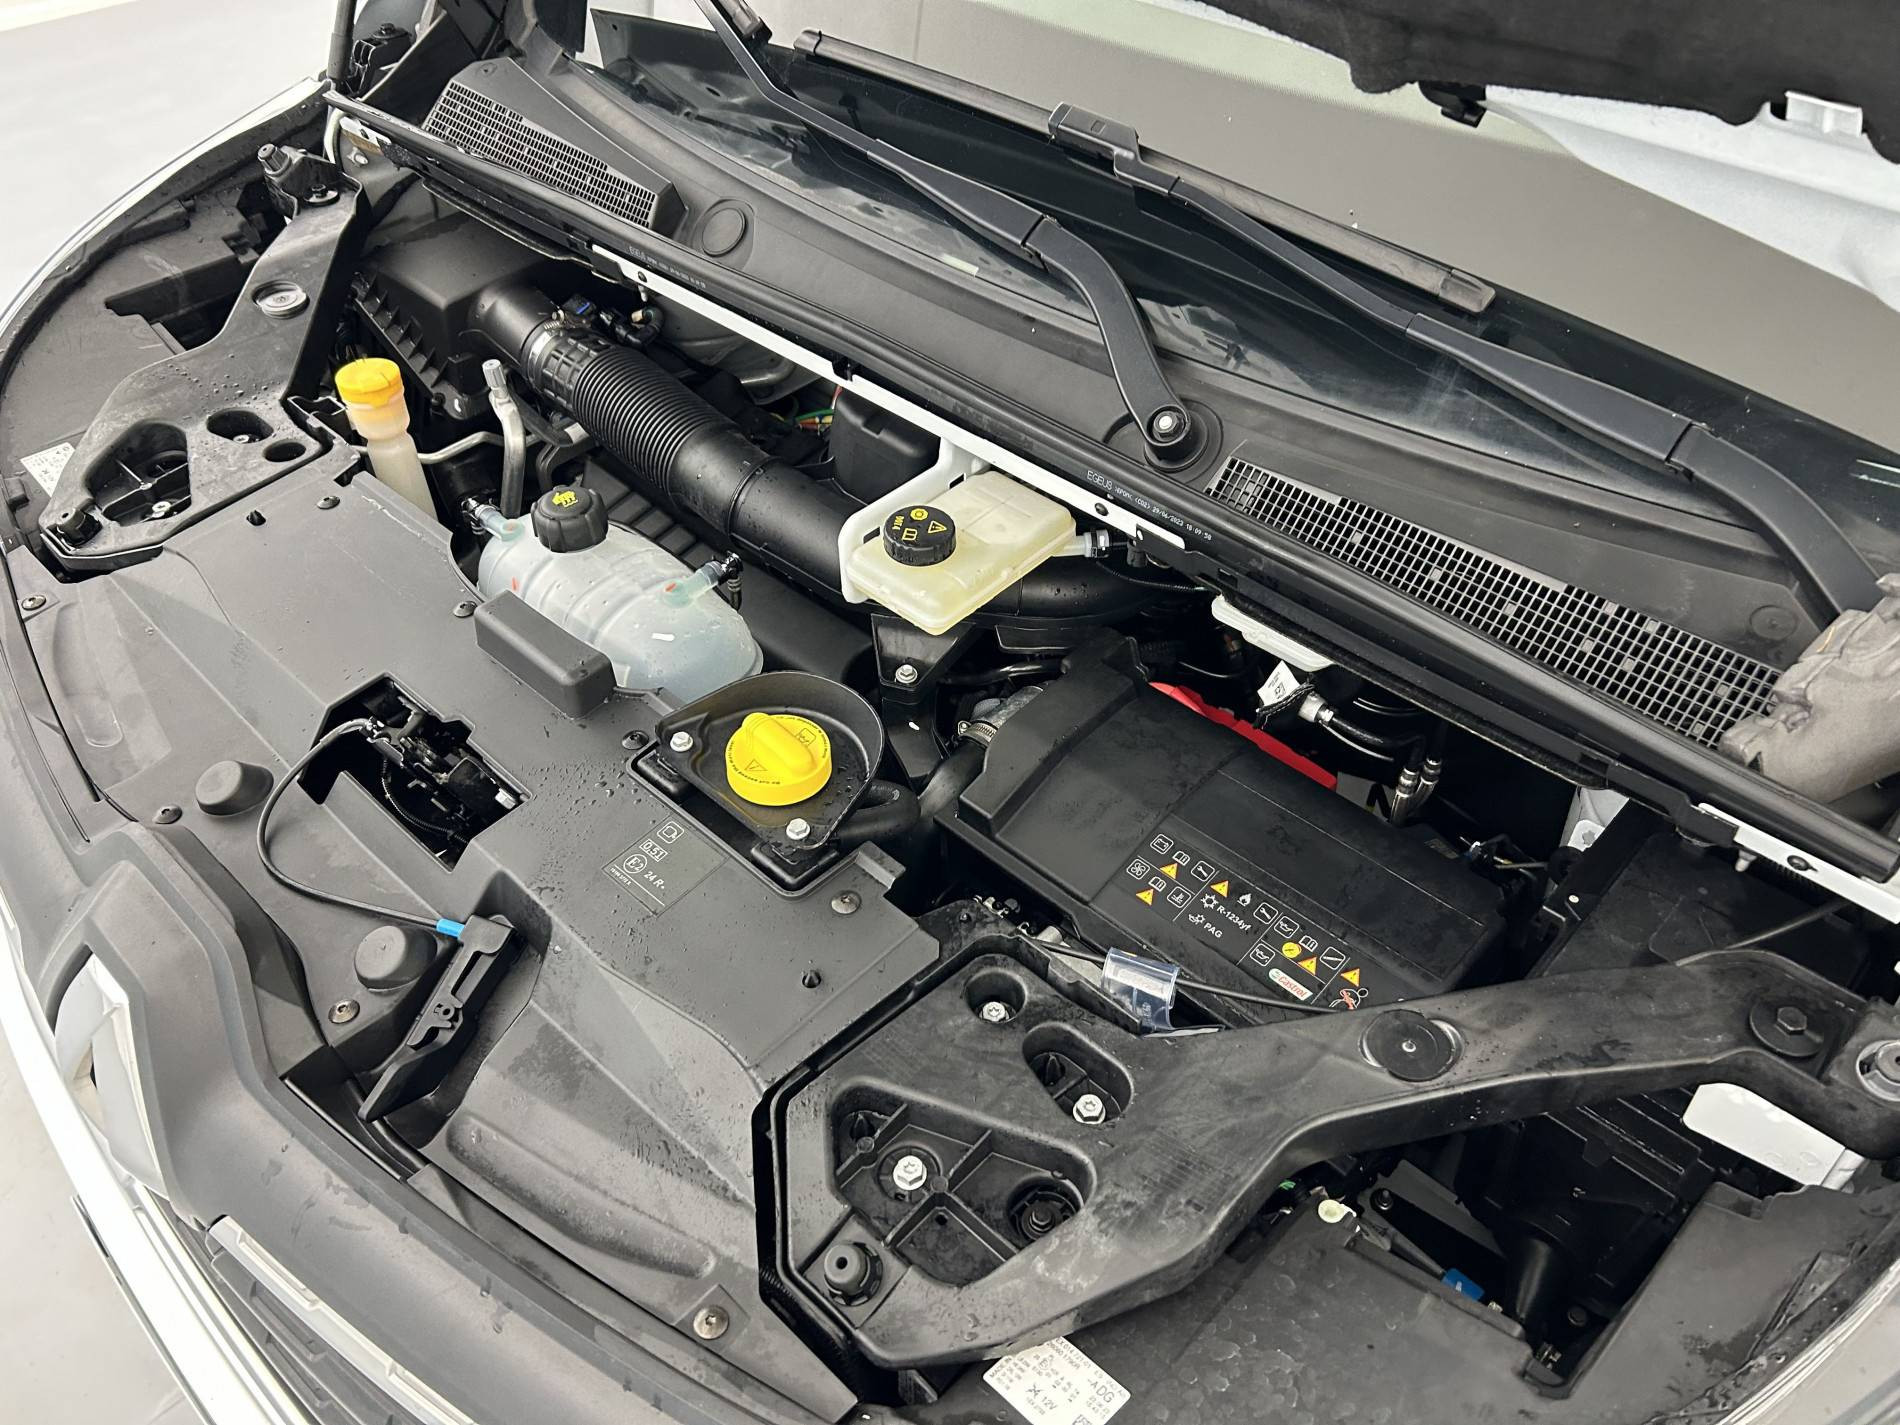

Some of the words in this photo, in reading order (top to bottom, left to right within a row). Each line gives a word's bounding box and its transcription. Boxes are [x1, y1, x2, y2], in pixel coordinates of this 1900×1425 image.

[626, 856, 644, 871] E2
[1216, 904, 1252, 932] R-1234yf
[1203, 922, 1223, 939] PAG
[1277, 975, 1310, 1000] Castrol
[1041, 1396, 1058, 1410] 12V
